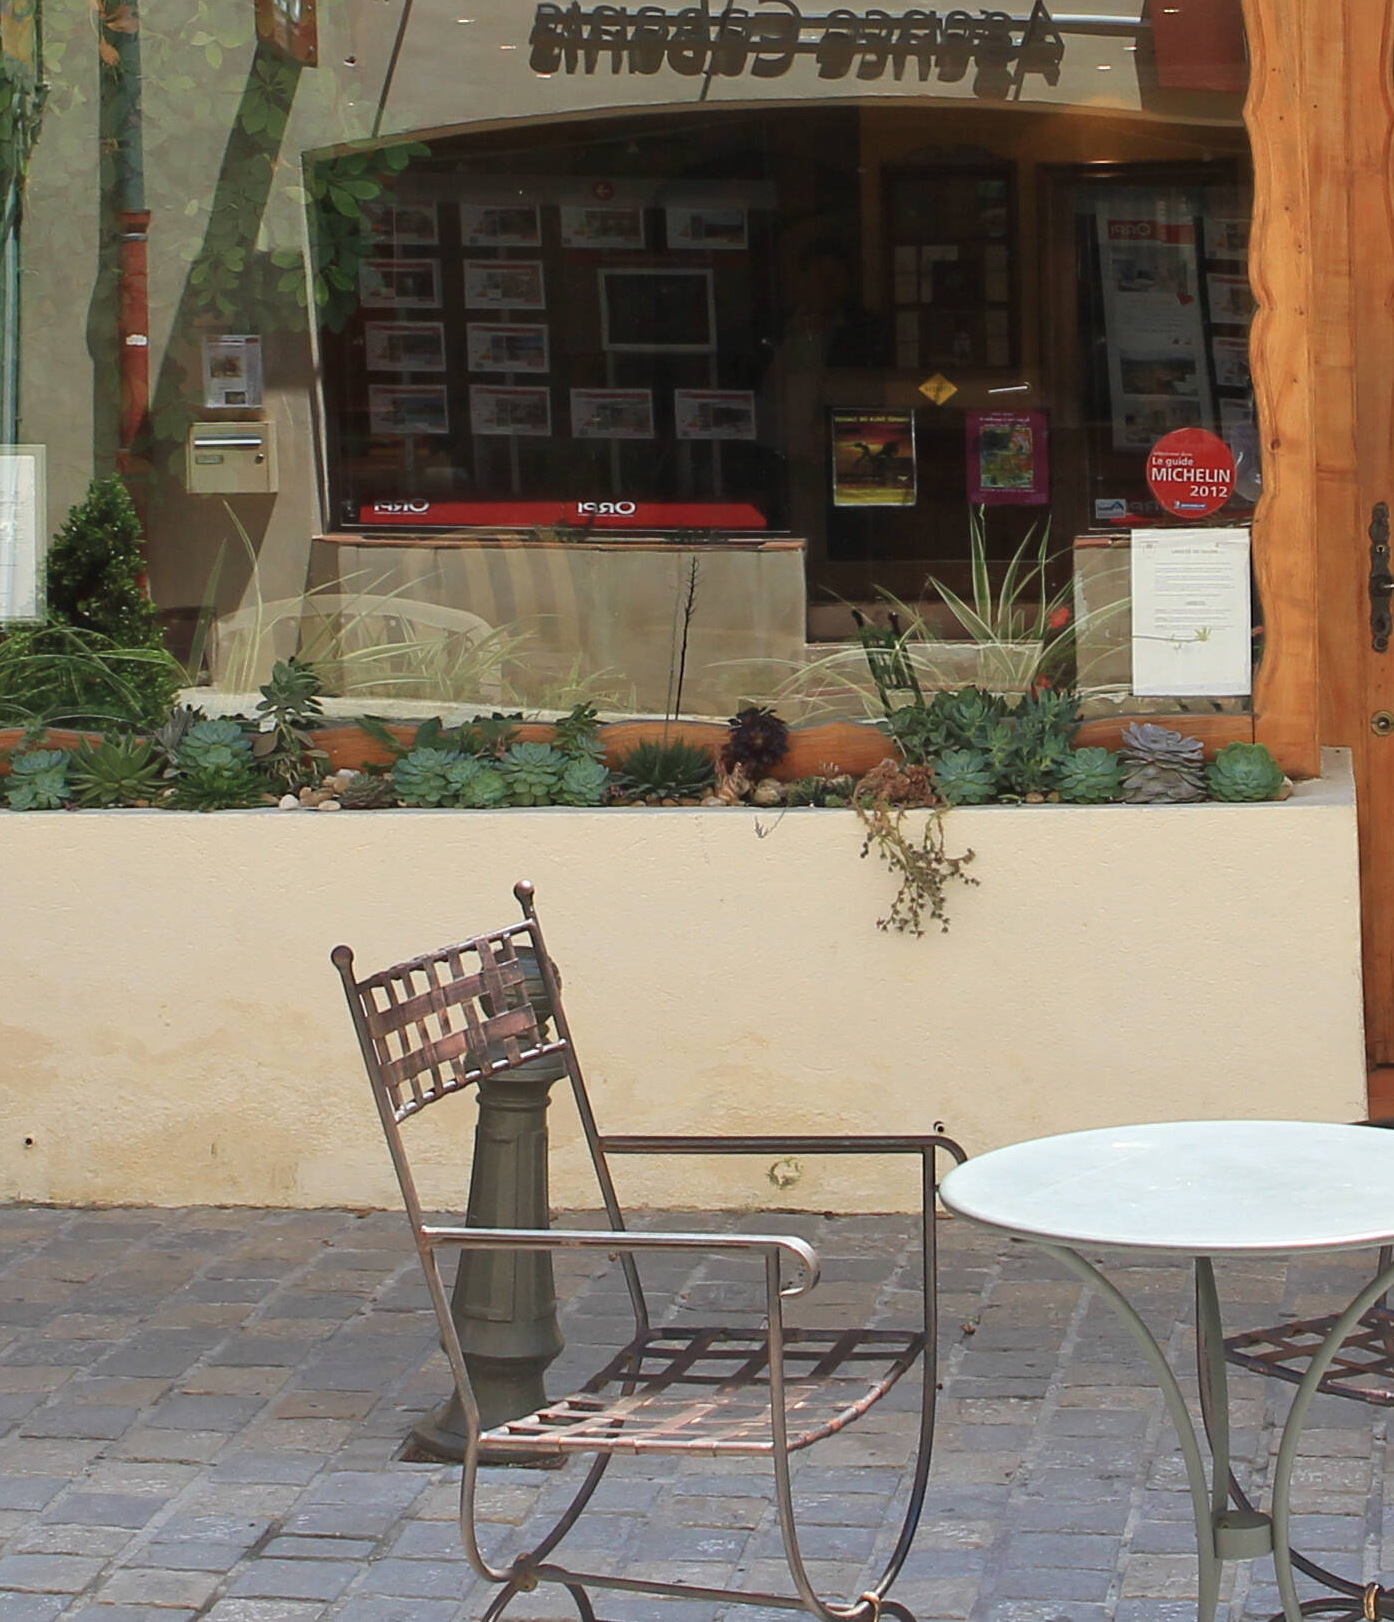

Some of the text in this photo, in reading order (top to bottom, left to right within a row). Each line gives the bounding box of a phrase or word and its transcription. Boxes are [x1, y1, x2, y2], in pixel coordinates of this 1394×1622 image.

[1152, 457, 1194, 466] Le guide
[1151, 468, 1230, 483] MICHELIN
[1190, 485, 1228, 497] 2012
